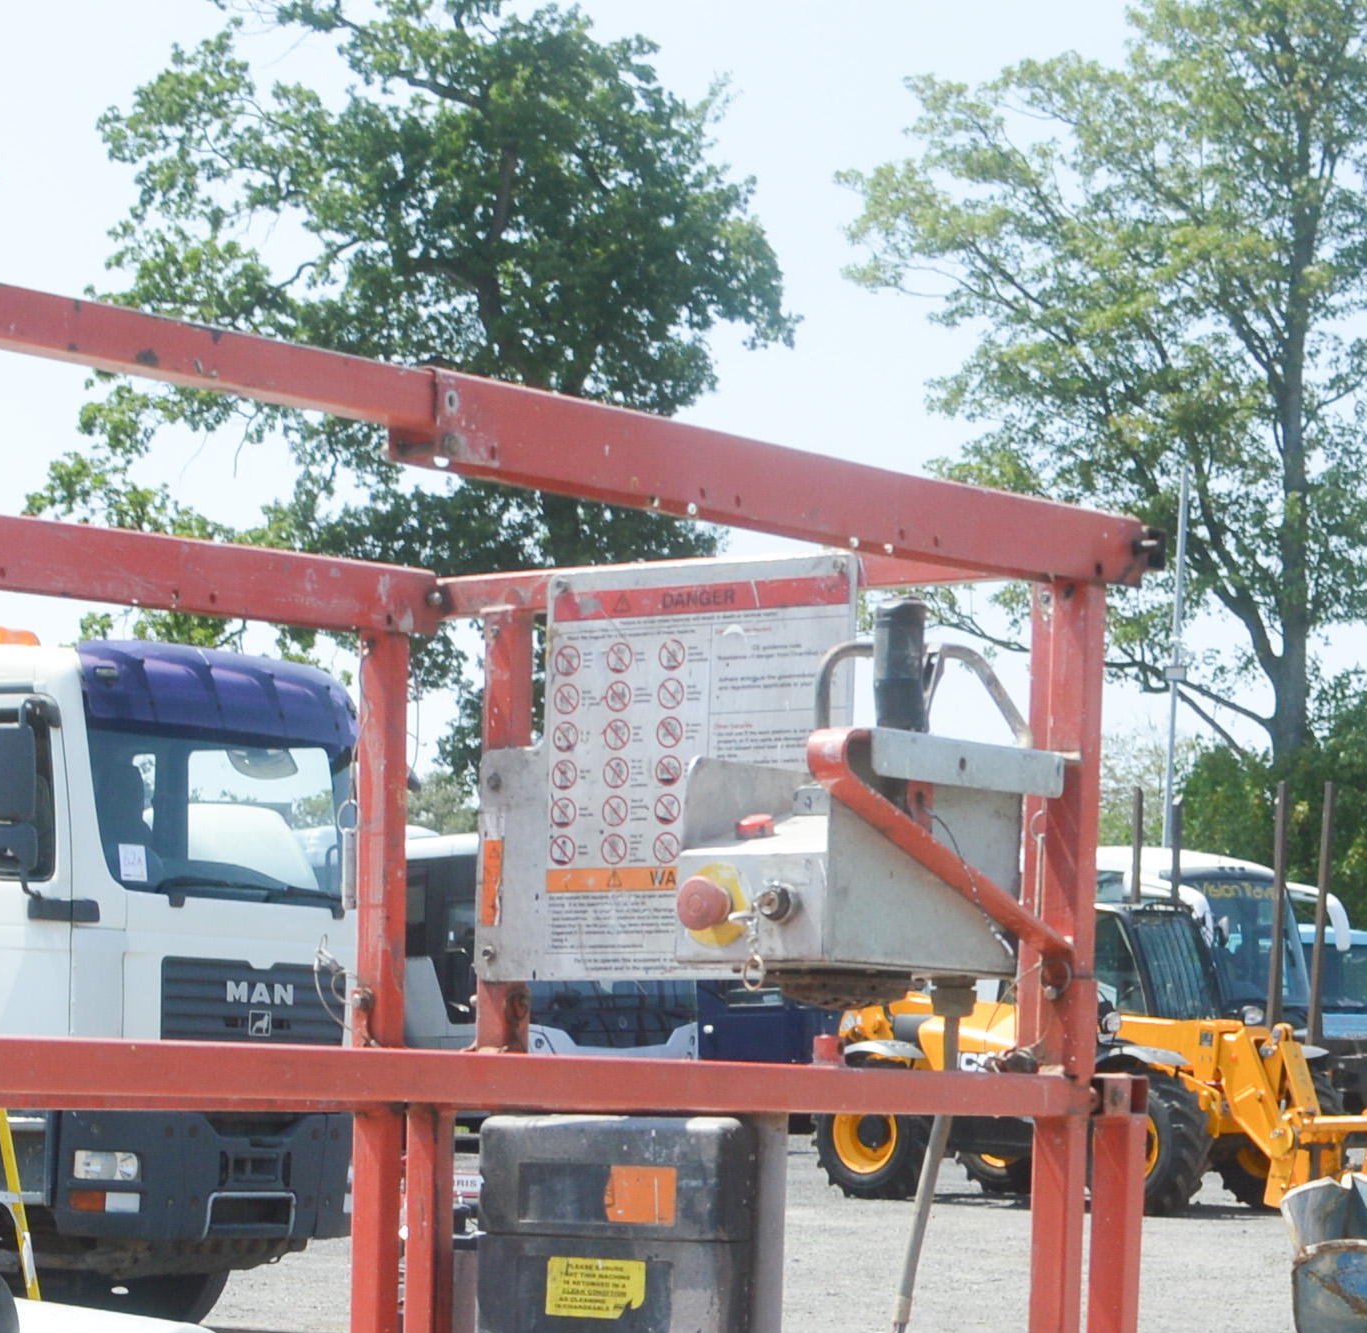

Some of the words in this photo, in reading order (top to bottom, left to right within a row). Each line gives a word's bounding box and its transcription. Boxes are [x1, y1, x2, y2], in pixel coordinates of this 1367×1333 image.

[662, 589, 735, 609] DANGER
[1194, 881, 1242, 899] Vision
[226, 980, 294, 1006] MAN
